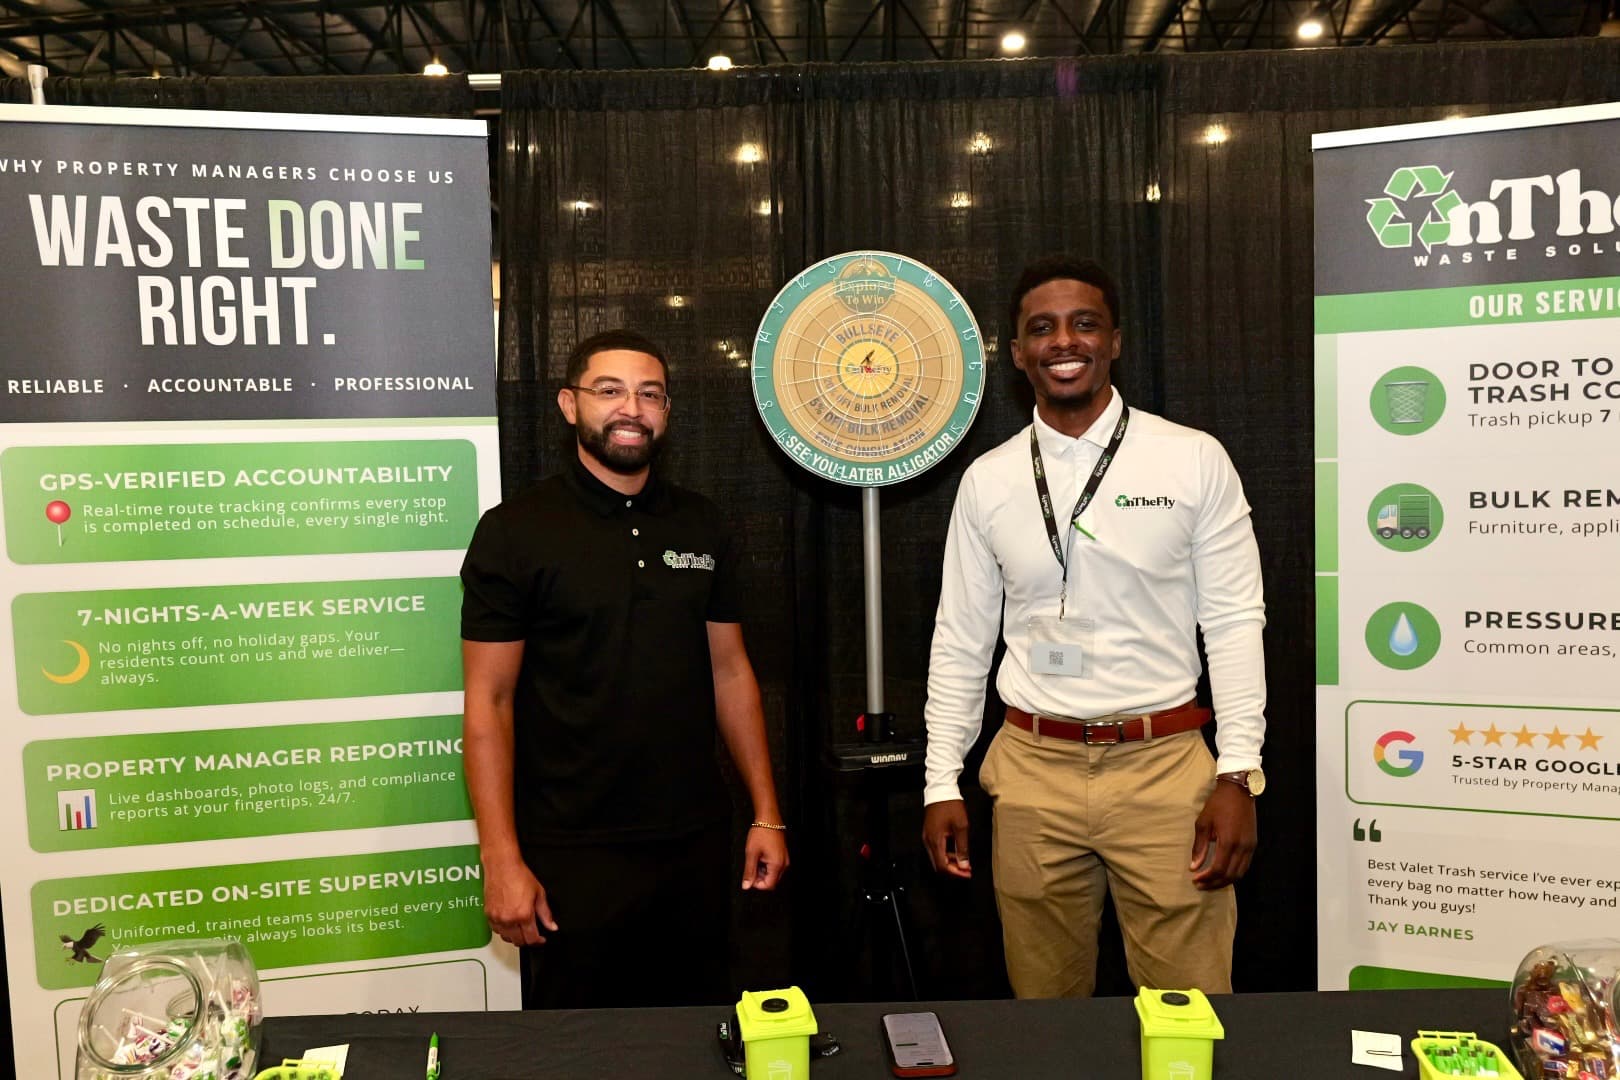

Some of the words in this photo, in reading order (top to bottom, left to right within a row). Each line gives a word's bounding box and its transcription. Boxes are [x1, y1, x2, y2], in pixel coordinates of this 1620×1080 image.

[57, 160, 178, 177] PROPERTY
[192, 164, 317, 180] MANAGERS
[329, 168, 416, 183] CHOOSE
[429, 171, 454, 184] US
[28, 194, 249, 269] WASTE
[268, 199, 424, 270] DONE
[1414, 249, 1517, 267] WASTE
[138, 276, 336, 346] RIGHT.
[1469, 293, 1523, 318] OUR
[1535, 287, 1620, 315] SERVI
[835, 323, 900, 345] BULLSEYE
[1469, 360, 1560, 381] DOOR
[1571, 357, 1614, 377] TO
[8, 379, 104, 394] RELIABLE
[148, 377, 293, 393] ACCOUNTABLE
[334, 376, 474, 391] PROFESSIONAL
[880, 376, 913, 410] REMOVAL
[1468, 383, 1570, 404] TRASH
[882, 395, 929, 434] REMOVAL
[1468, 411, 1520, 428] Trash
[1528, 409, 1592, 429] pickup
[1600, 409, 1611, 423] 7
[786, 436, 812, 461] SEE
[811, 453, 838, 475] YOU
[841, 465, 883, 481] LATER
[888, 433, 954, 479] ALLIGATOR
[40, 470, 226, 492] GPS-VERIFIED
[234, 465, 453, 487] ACCOUNTABILITY
[83, 499, 163, 518] Real-time
[168, 501, 214, 516] route
[219, 499, 285, 517] tracking
[290, 496, 360, 513] confirms
[365, 499, 409, 514] every
[413, 497, 447, 512] stop
[1469, 490, 1551, 509] BULK
[84, 518, 97, 533] is
[103, 514, 191, 535] completed
[196, 518, 218, 531] on
[223, 512, 300, 530] schedule,
[305, 514, 348, 530] every
[353, 510, 400, 528] single
[405, 509, 449, 527] night.
[1469, 520, 1564, 536] Furniture,
[1571, 518, 1619, 538] appli
[77, 600, 315, 626] 7-NIGHTS-A-WEEK
[322, 595, 426, 617] SERVICE
[1464, 611, 1620, 631] PRESSURE
[99, 640, 121, 654] No
[127, 635, 176, 655] nights
[181, 635, 208, 652] off,
[213, 637, 233, 650] no
[238, 631, 295, 650] holiday
[300, 632, 340, 649] gaps.
[345, 628, 381, 644] Your
[1464, 639, 1549, 656] Common
[1557, 644, 1616, 659] areas,
[100, 652, 175, 669] residents
[180, 650, 225, 666] count
[230, 651, 250, 664] on
[255, 650, 273, 663] us
[278, 645, 307, 661] and
[312, 648, 334, 660] we
[100, 670, 159, 688] always.
[47, 756, 187, 782] PROPERTY
[195, 747, 321, 772] MANAGER
[1452, 755, 1527, 771] 5-STAR
[1535, 758, 1620, 776] GOOGL
[109, 793, 140, 805] Live
[146, 785, 243, 803] dashboards,
[249, 780, 294, 798] photo
[299, 779, 333, 794] logs,
[339, 776, 366, 789] and
[372, 771, 456, 787] compliance
[1452, 774, 1499, 788] Trusted
[1503, 777, 1518, 790] by
[1522, 778, 1578, 793] Property
[1582, 782, 1620, 795] Mana
[110, 804, 169, 822] reports
[174, 803, 189, 816] at
[194, 802, 229, 818] your
[235, 795, 312, 814] fingertips,
[318, 792, 356, 806] 24/7.
[1368, 859, 1396, 871] Best
[1400, 861, 1434, 875] Valet
[1438, 864, 1476, 878] Trash
[1480, 870, 1528, 882] service
[1560, 876, 1592, 887] ever
[53, 888, 204, 917] DEDICATED
[212, 879, 311, 903] ON-SITE
[319, 864, 481, 894] SUPERVISION
[1368, 878, 1403, 891] every
[1407, 879, 1432, 894] bag
[1436, 884, 1453, 894] no
[1457, 886, 1504, 898] matter
[1508, 888, 1539, 901] how
[1543, 890, 1585, 908] heavy
[1590, 896, 1617, 907] and
[1368, 894, 1408, 907] Thank
[1412, 900, 1437, 911] you
[1441, 903, 1476, 915] guys!
[111, 921, 200, 940] Uniformed,
[206, 915, 261, 932] trained
[267, 912, 313, 927] teams
[318, 903, 398, 922] supervised
[404, 899, 443, 914] every
[448, 895, 484, 910] shift.
[247, 929, 297, 943] always
[302, 920, 342, 937] looks
[347, 920, 364, 933] its
[369, 918, 405, 932] best.
[1368, 920, 1399, 933] JAY
[1404, 924, 1474, 941] BARNES
